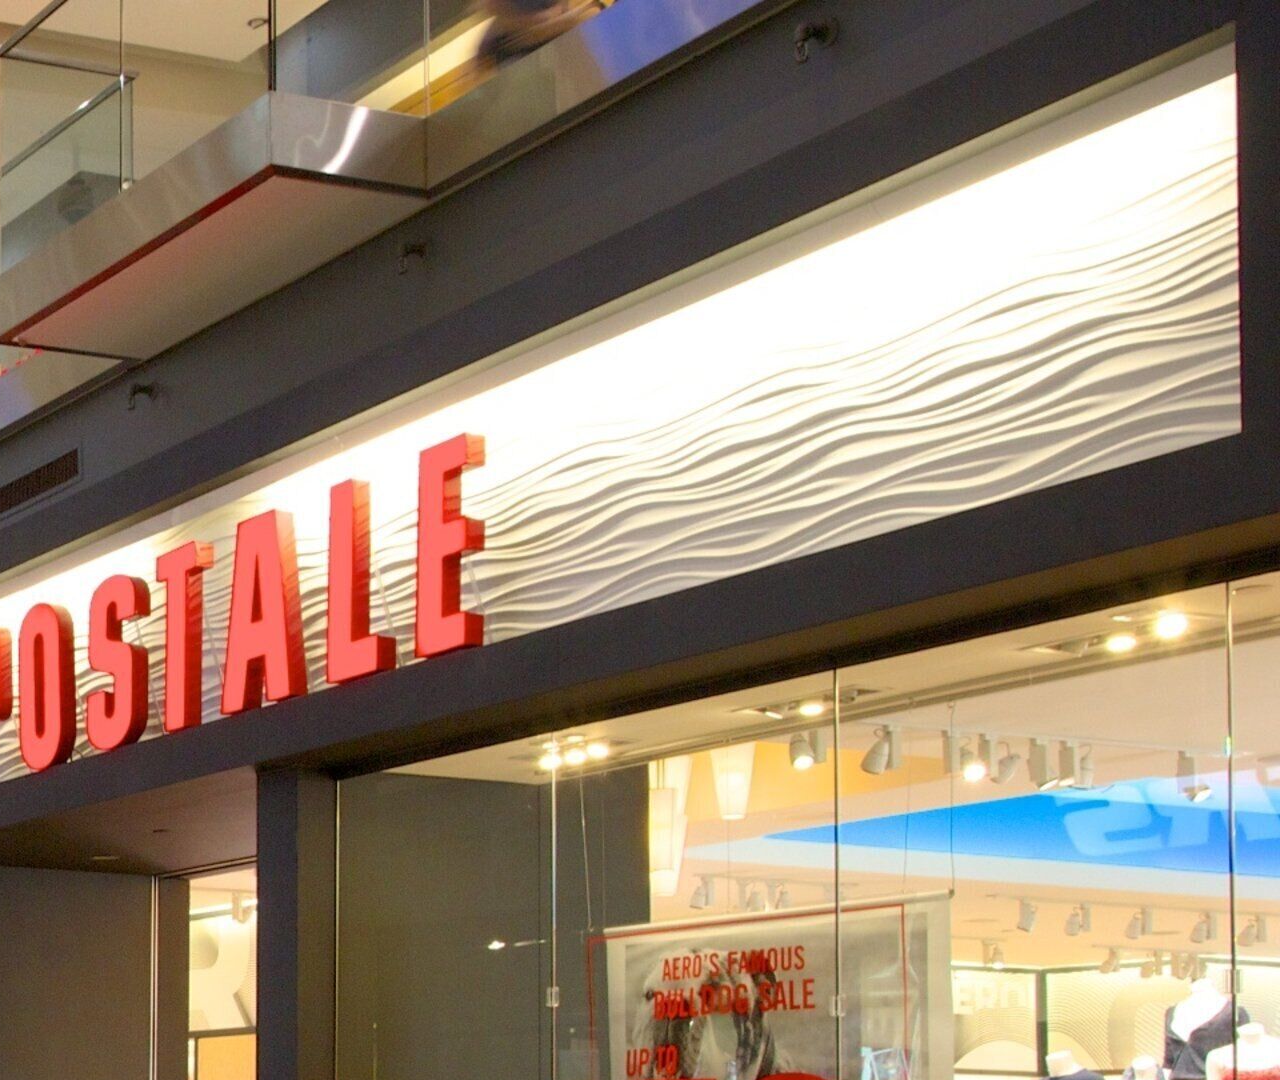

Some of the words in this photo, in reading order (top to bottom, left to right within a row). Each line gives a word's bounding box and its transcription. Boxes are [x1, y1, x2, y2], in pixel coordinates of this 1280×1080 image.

[662, 952, 720, 982] AERO'S
[727, 945, 806, 976] FAMOUS
[653, 982, 749, 1022] BULLDOG
[758, 978, 816, 1012] SALE
[626, 1048, 650, 1078] UP
[656, 1043, 680, 1077] TO
